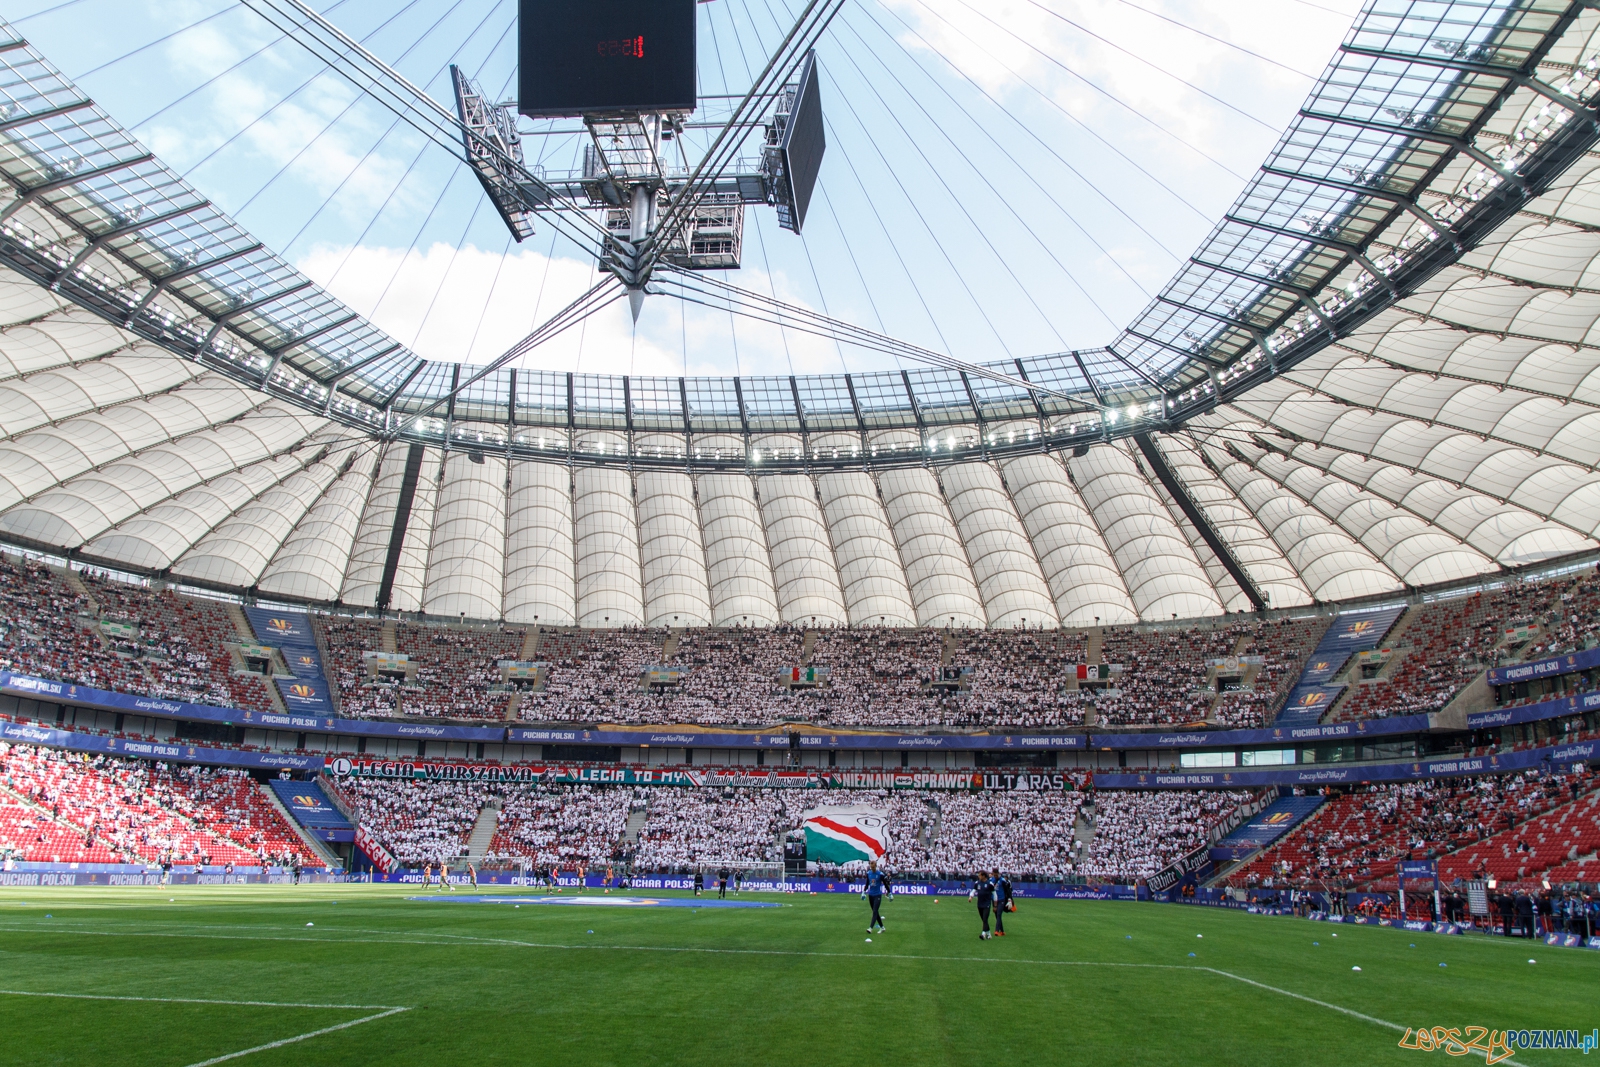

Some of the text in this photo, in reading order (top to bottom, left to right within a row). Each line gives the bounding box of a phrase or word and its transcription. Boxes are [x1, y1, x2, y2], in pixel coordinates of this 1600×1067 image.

[1506, 662, 1558, 678] PUCHAR POLSKI
[9, 676, 62, 694] PUCHAR POLSKI
[262, 715, 290, 725] PUCHAR
[292, 718, 317, 727] POLSKI
[1292, 726, 1348, 737] PUCHAR POLSKI
[124, 743, 151, 753] PUCHAR
[154, 746, 179, 756] POLSKI
[358, 761, 415, 777] LEGIA
[423, 764, 532, 781] WARSZAWA
[1429, 760, 1482, 773] PUCHAR POLSKI
[580, 770, 683, 782] LEGIA TO MY
[842, 773, 894, 788] NIEZNANI
[914, 774, 973, 788] SPRAWCY
[1157, 776, 1185, 784] PUCHAR
[360, 832, 392, 874] LEGIA
[41, 874, 76, 885] POLSKI
[109, 874, 143, 885] PUCHAR
[197, 875, 224, 884] PUCHAR
[892, 886, 927, 894] POLSKI
